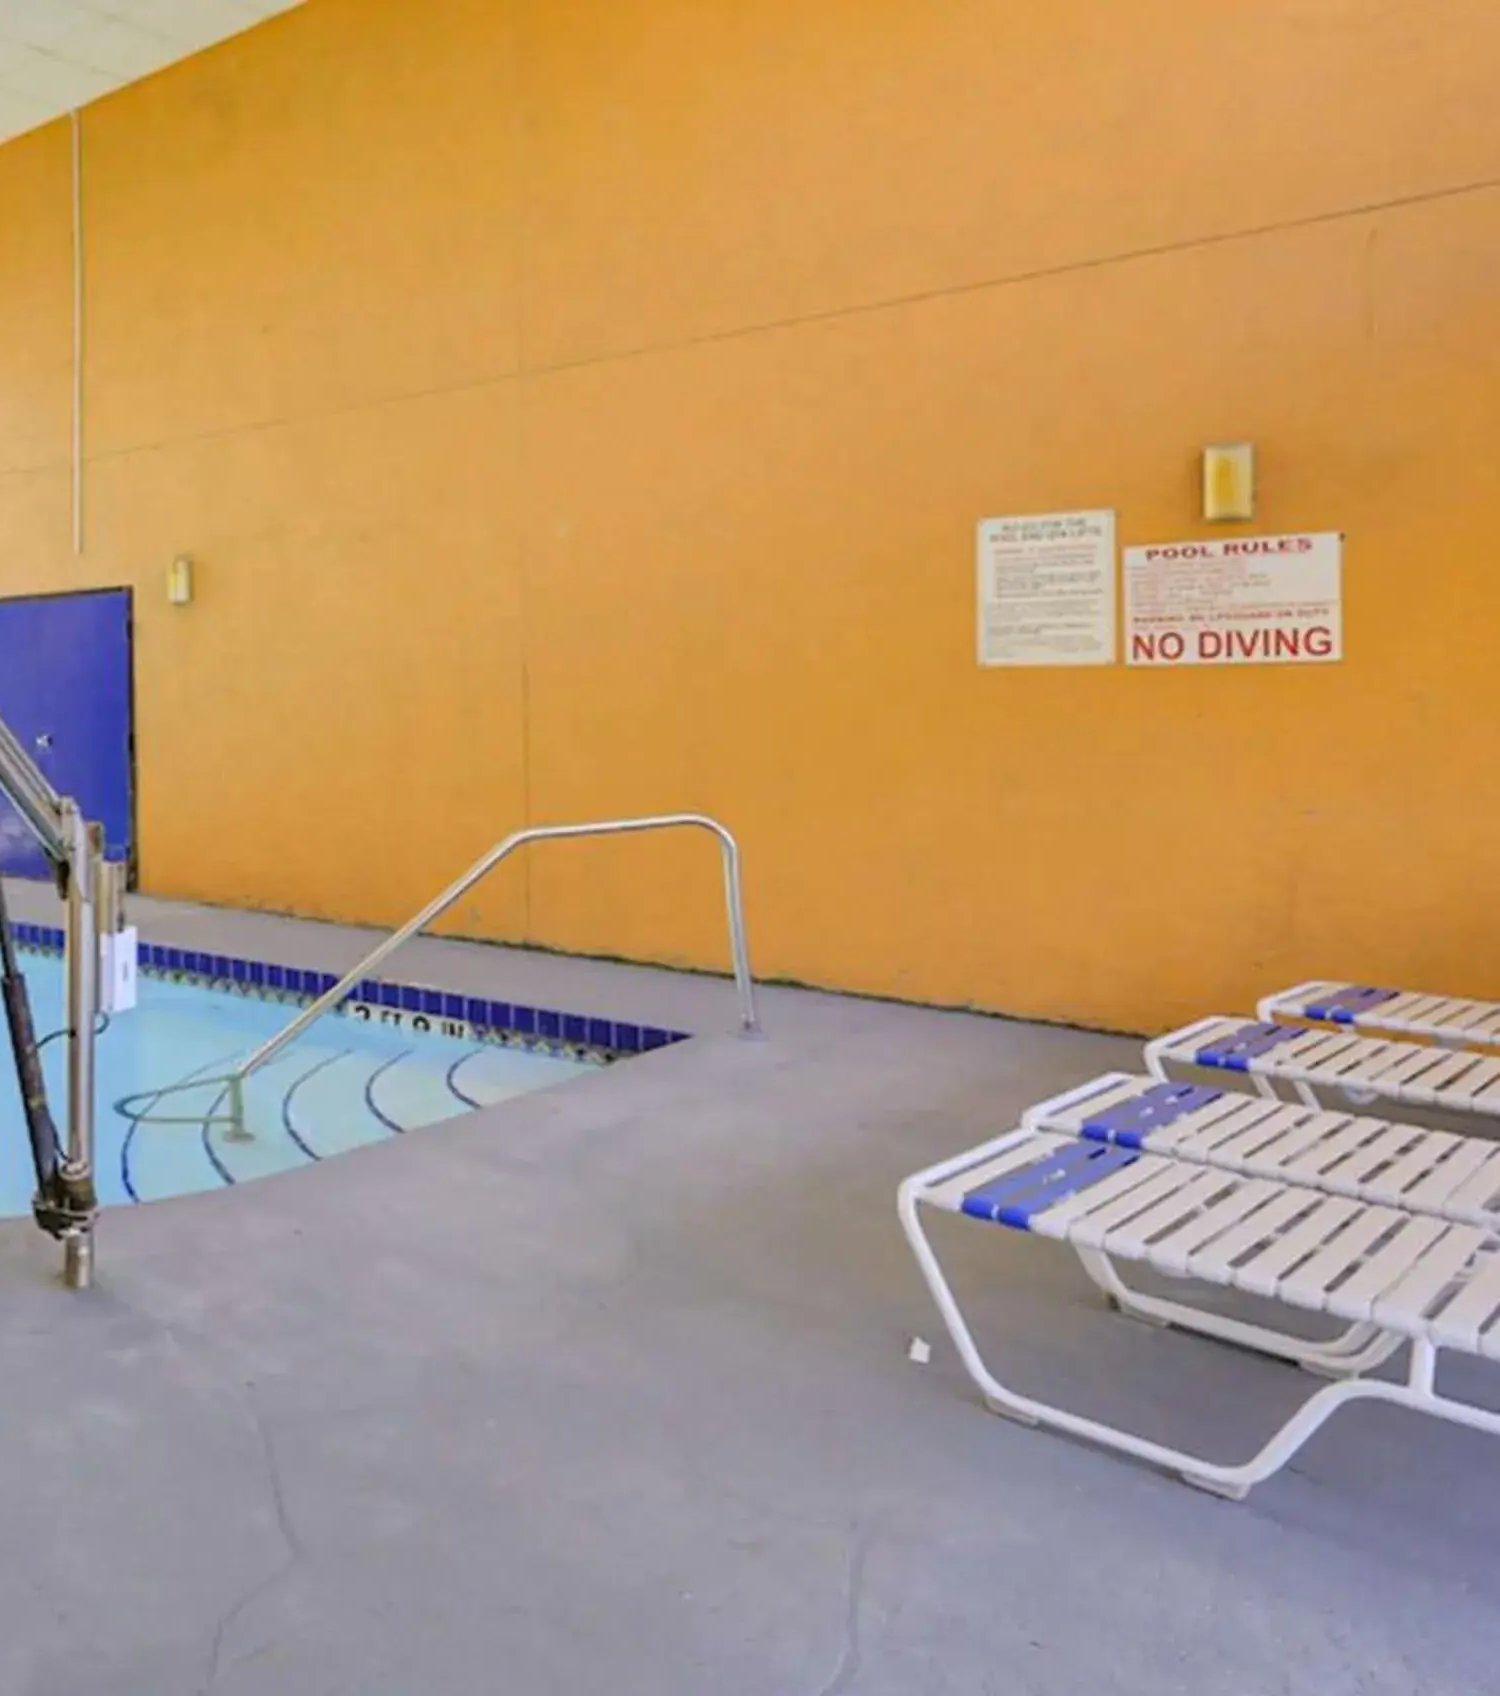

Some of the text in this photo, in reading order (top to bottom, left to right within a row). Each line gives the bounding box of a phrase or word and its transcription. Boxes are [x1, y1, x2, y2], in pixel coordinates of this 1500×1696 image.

[1145, 538, 1313, 561] POOL RULES
[1133, 626, 1332, 660] NO DIVING
